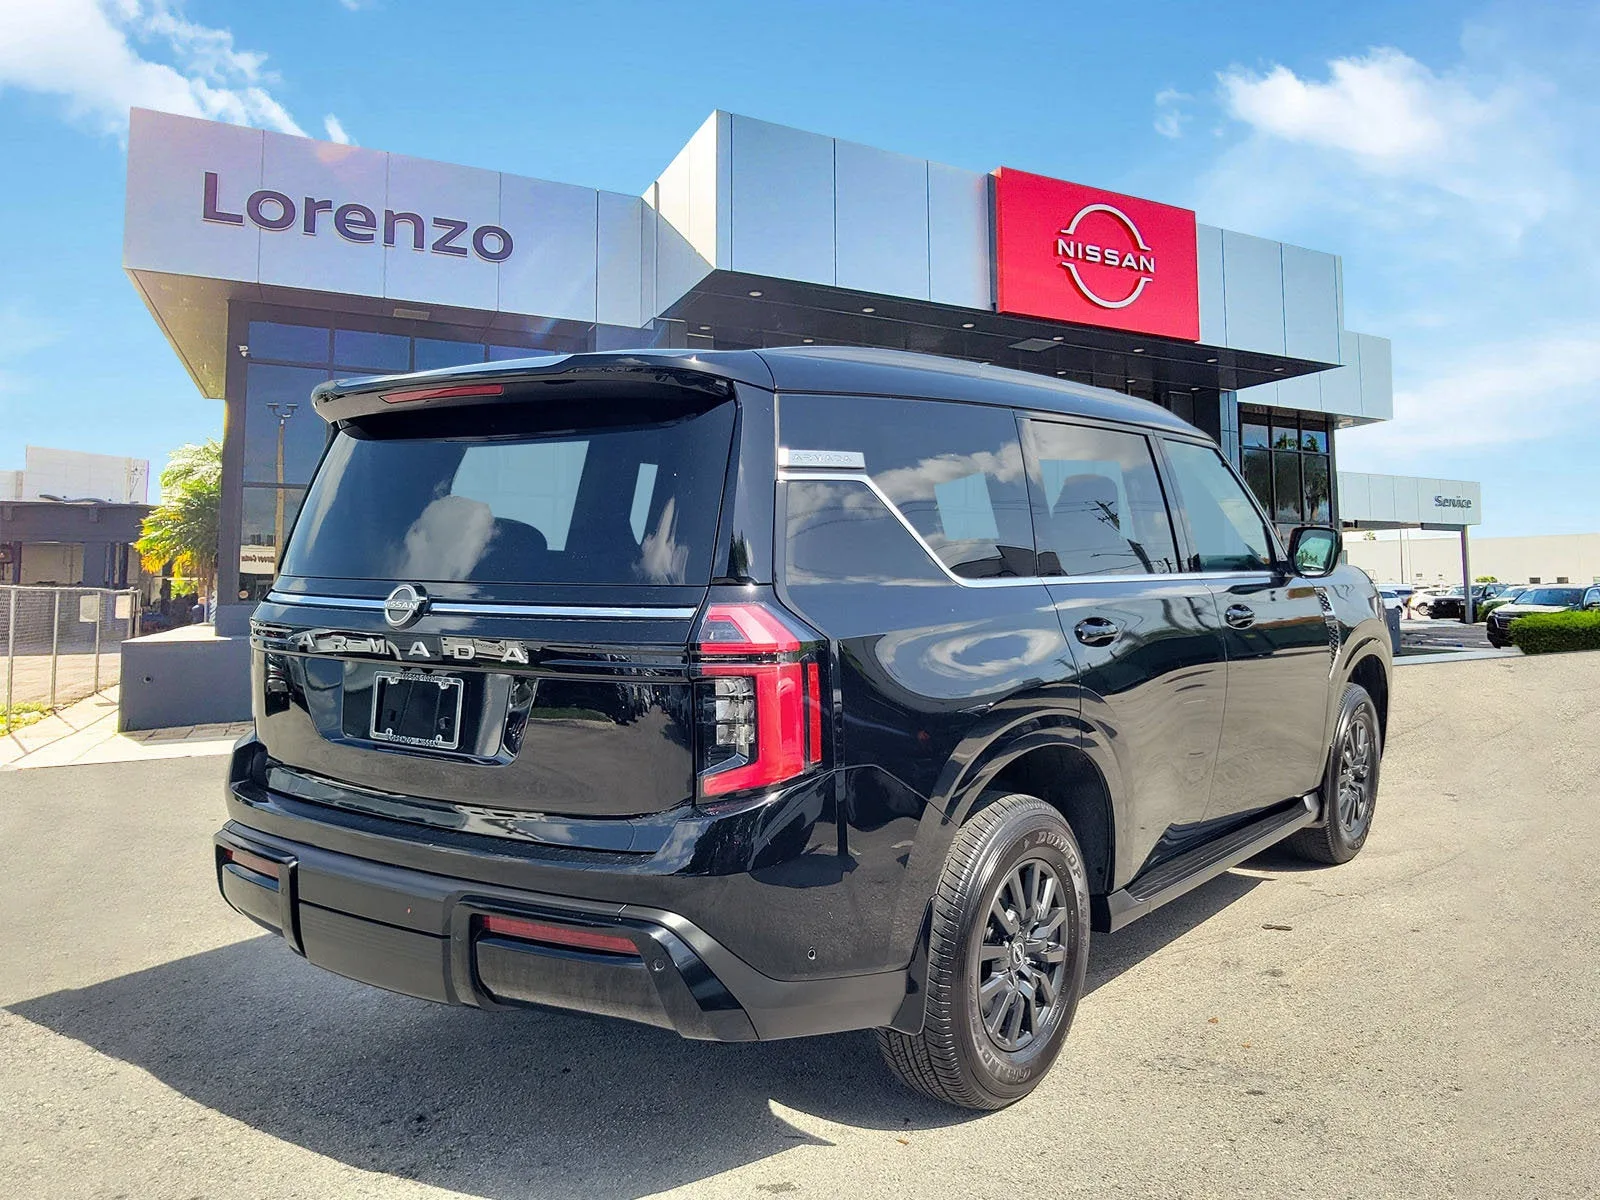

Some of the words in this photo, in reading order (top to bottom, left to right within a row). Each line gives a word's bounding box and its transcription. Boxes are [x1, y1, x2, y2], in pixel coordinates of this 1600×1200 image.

[202, 171, 514, 264] Lorenzo
[1057, 238, 1155, 273] NISSAN
[1434, 495, 1472, 508] Service
[385, 600, 418, 610] NISSAN
[299, 633, 529, 664] ARMADA
[1035, 831, 1083, 879] DUNLOP
